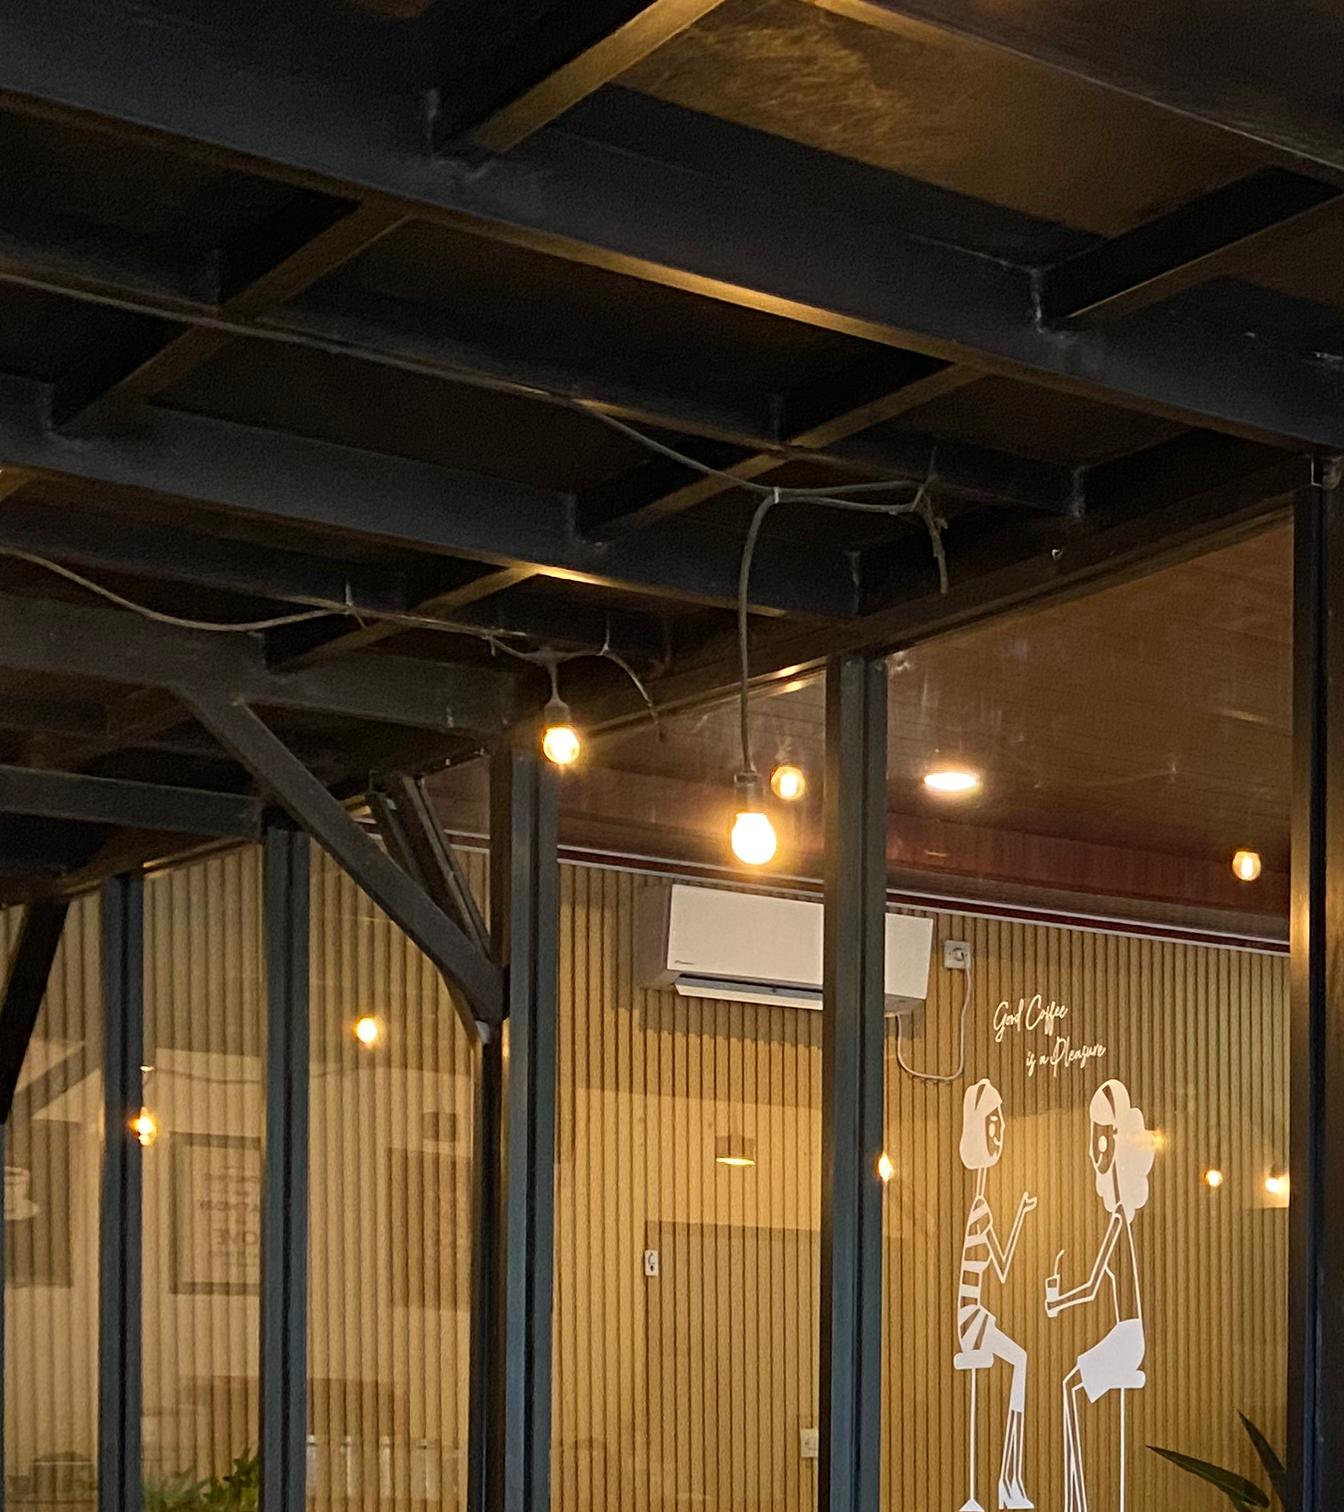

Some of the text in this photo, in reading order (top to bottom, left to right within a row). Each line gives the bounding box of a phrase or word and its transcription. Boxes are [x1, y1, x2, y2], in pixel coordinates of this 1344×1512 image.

[992, 993, 1069, 1043] Good Coffee
[1025, 1050, 1037, 1077] is
